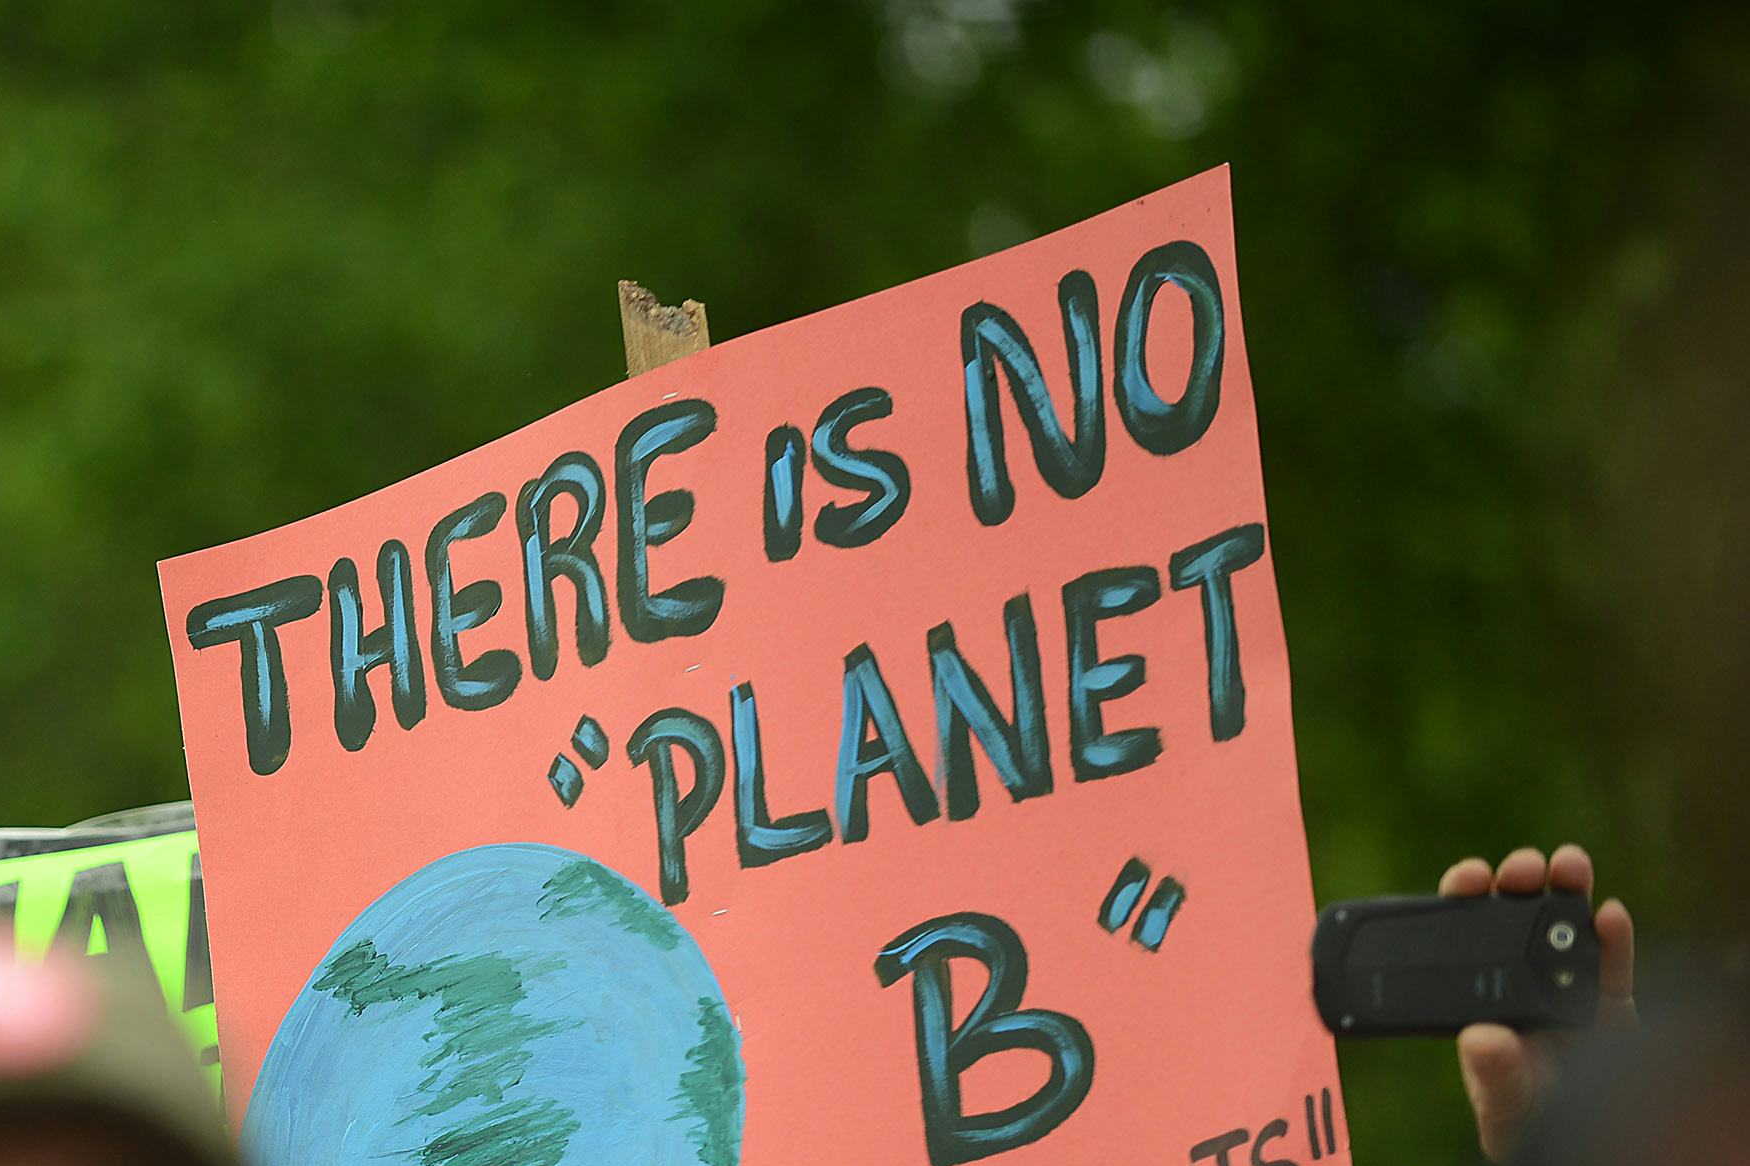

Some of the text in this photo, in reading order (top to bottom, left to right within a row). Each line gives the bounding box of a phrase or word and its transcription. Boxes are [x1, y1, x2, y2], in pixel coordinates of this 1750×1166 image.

[187, 240, 1225, 775] THERE IS NO
